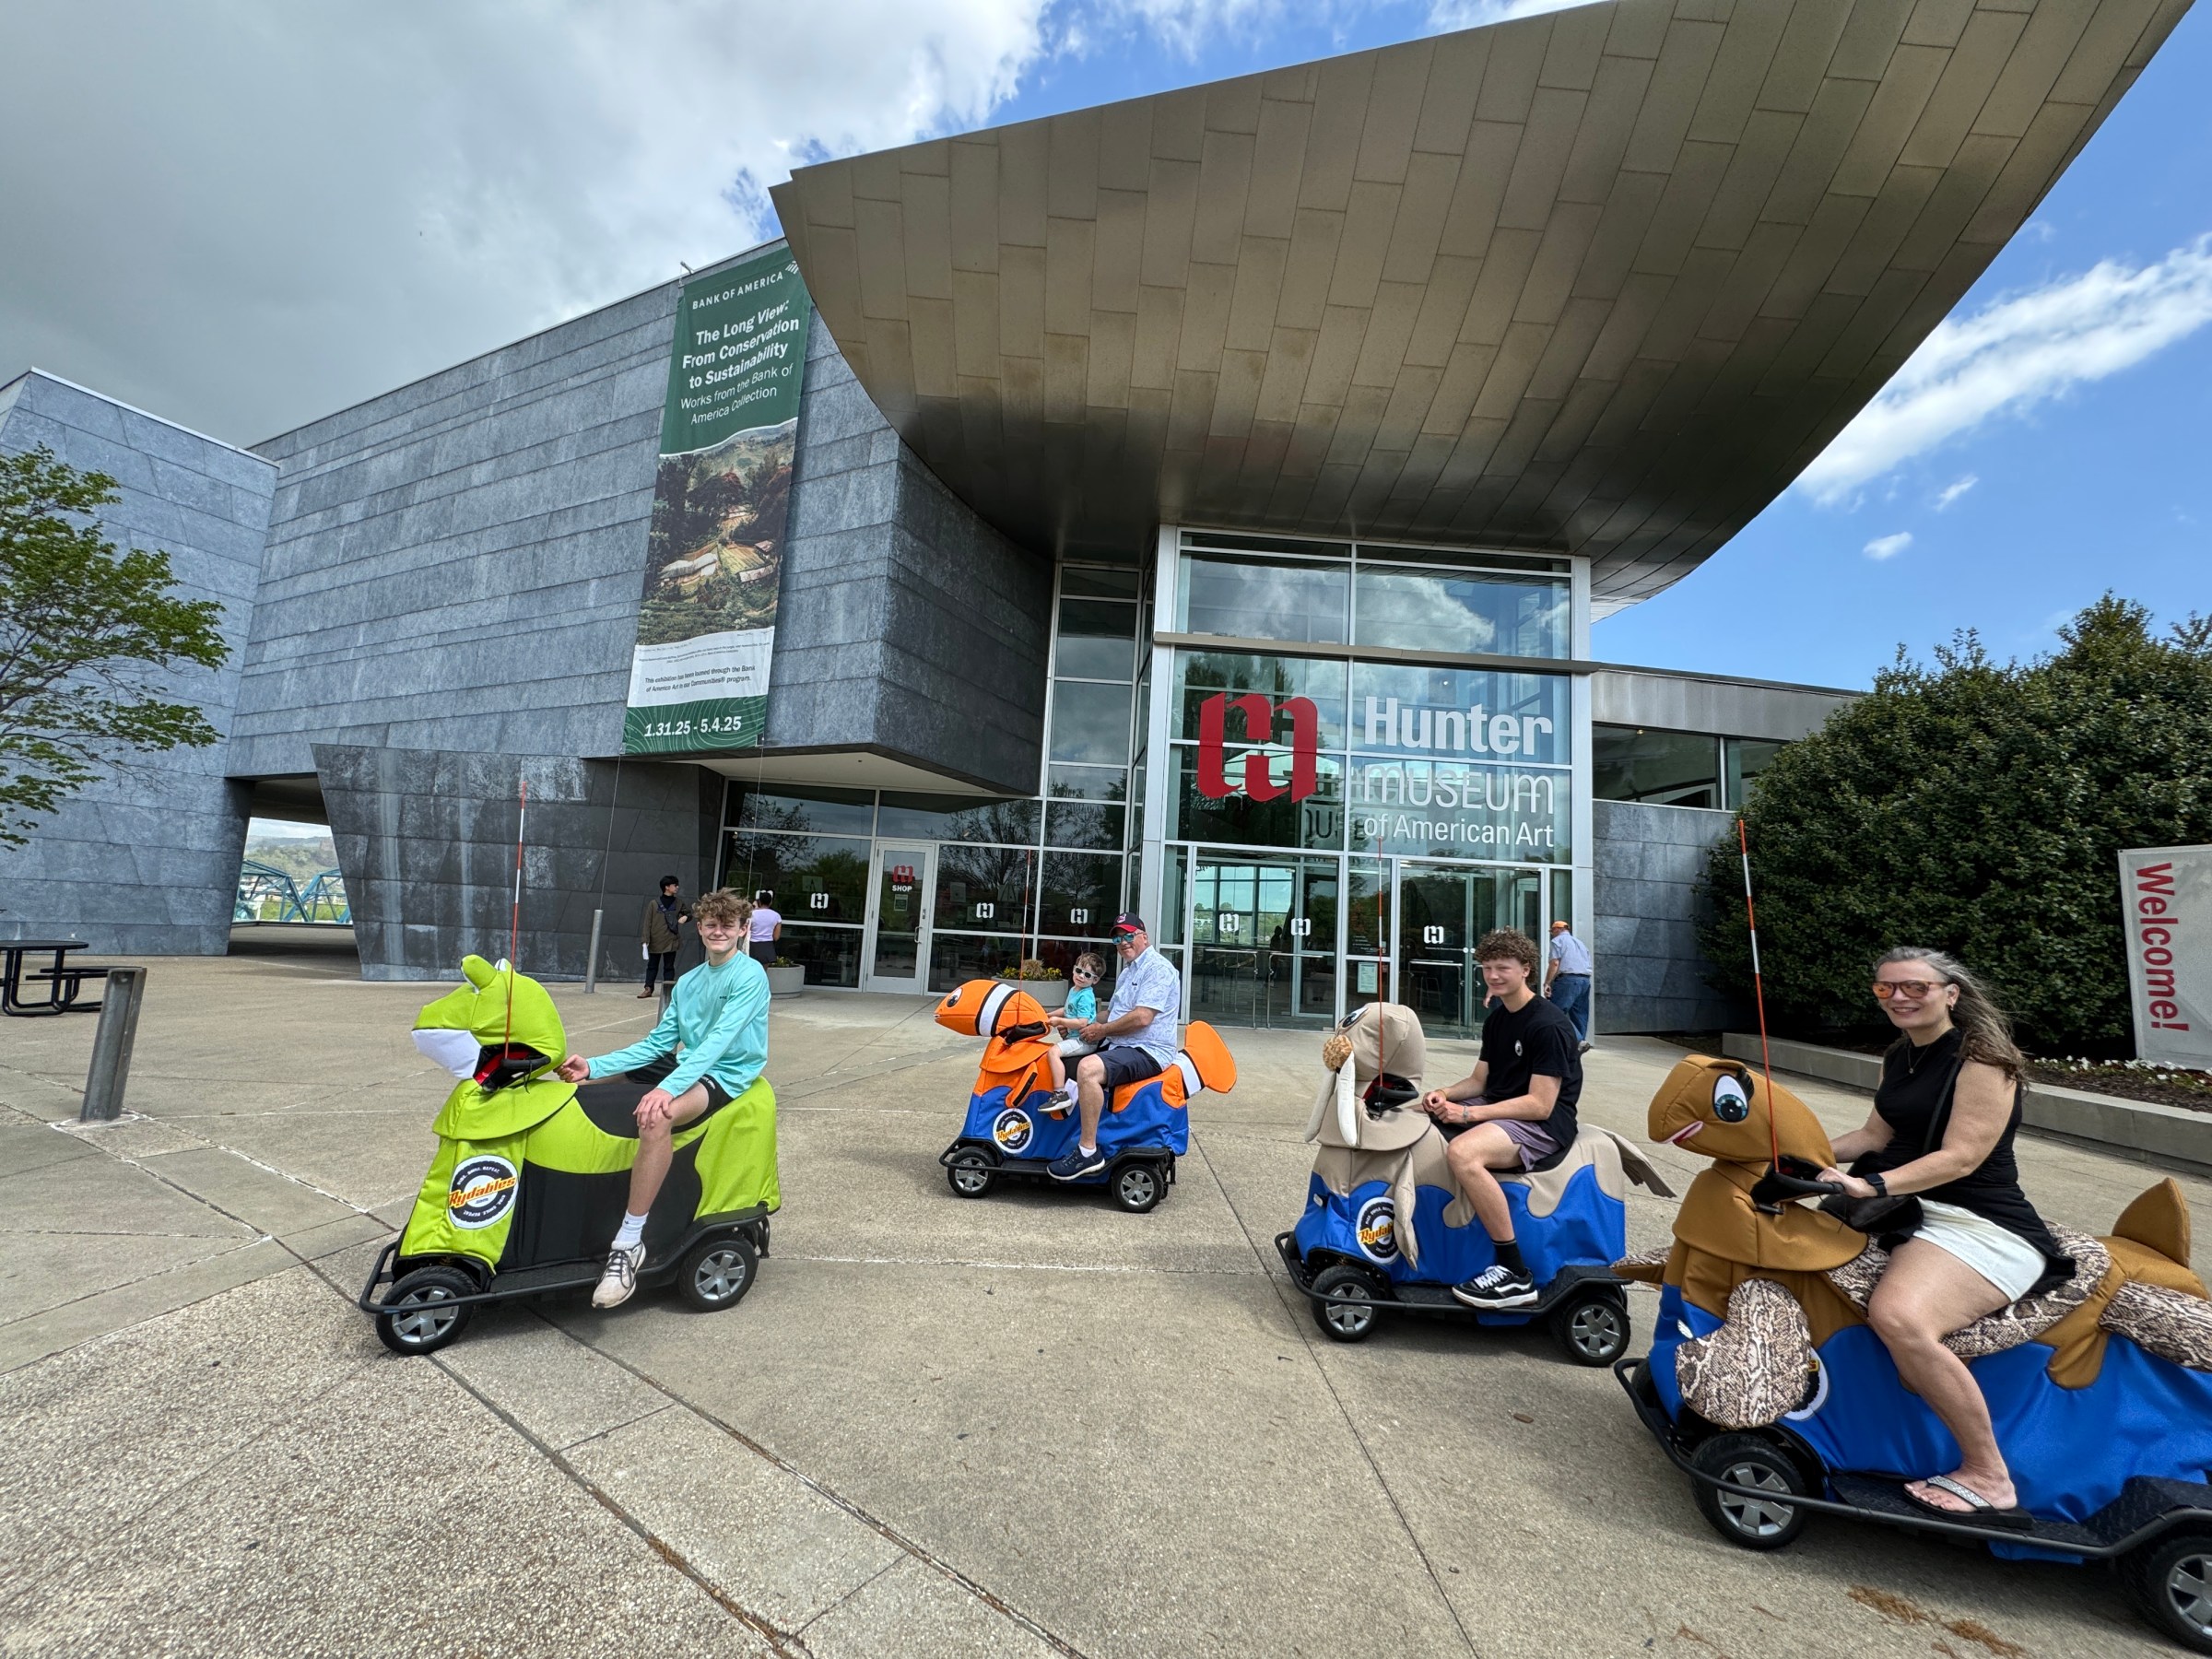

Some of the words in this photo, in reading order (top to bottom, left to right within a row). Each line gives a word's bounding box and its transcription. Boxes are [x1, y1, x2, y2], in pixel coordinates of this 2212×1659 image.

[692, 294, 720, 310] BANK
[722, 288, 735, 301] OF
[737, 271, 783, 296] AMERICA
[682, 351, 715, 369] From
[719, 318, 799, 360] Conservation
[696, 330, 719, 345] The
[723, 316, 755, 338] Long
[758, 300, 789, 324] View:
[681, 394, 712, 410] Works
[714, 387, 735, 402] from
[737, 378, 750, 392] the
[752, 366, 777, 384] Bank
[782, 363, 794, 377] of
[689, 376, 702, 389] to
[706, 342, 788, 385] Sustainability
[691, 406, 729, 425] America
[731, 386, 777, 412] Collection
[644, 721, 691, 737] 1.31.25
[700, 716, 742, 733] 5.4.25
[1364, 695, 1553, 756] Hunter
[1364, 813, 1388, 837] of
[1393, 814, 1511, 845] American
[1514, 822, 1554, 848] Art
[2136, 862, 2190, 1032] Welcome!
